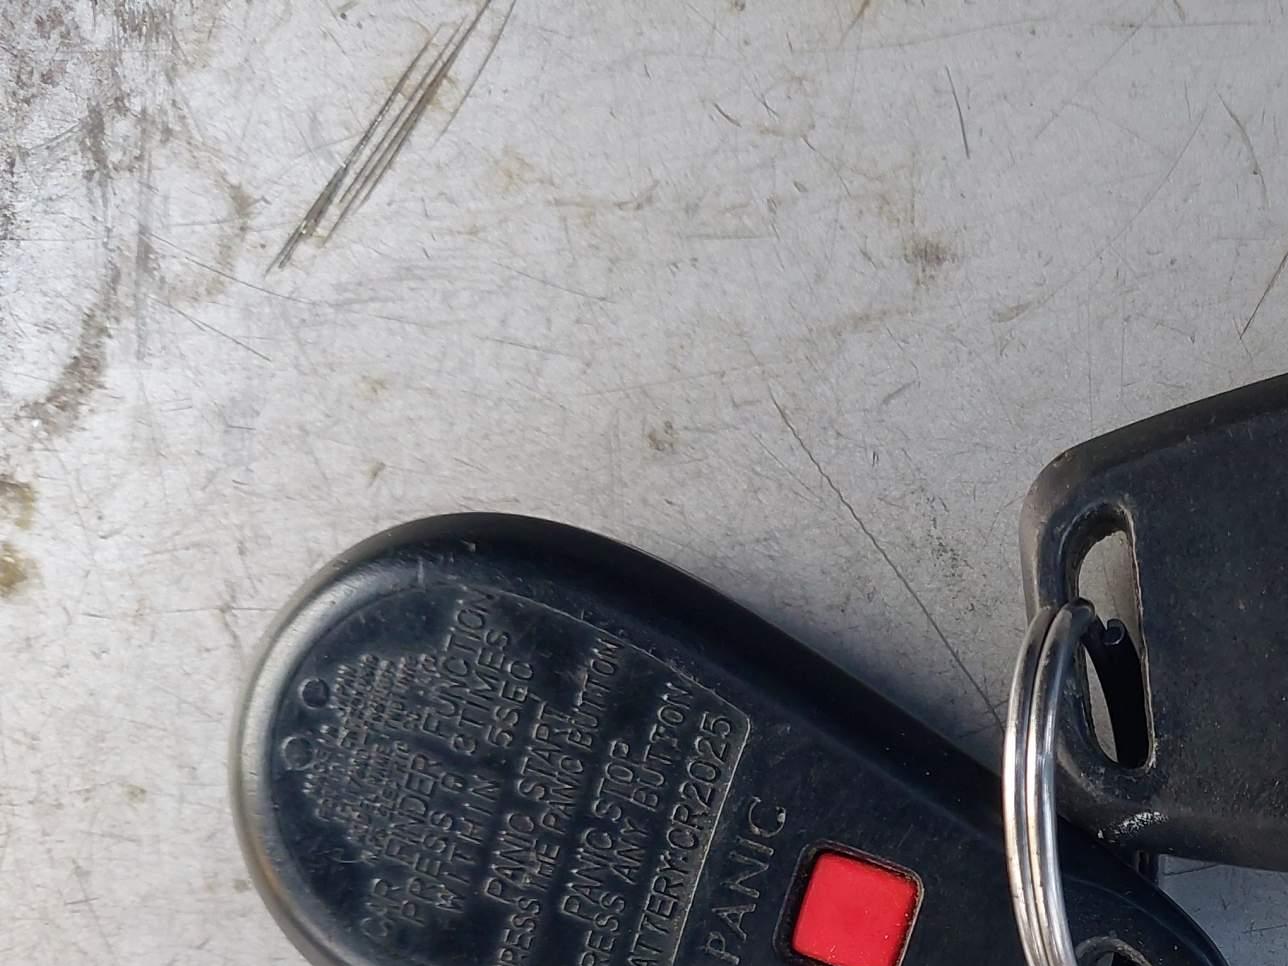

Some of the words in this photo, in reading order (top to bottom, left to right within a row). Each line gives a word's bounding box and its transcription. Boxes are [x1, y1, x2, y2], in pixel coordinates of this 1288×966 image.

[361, 878, 401, 937] CAR
[384, 754, 442, 866] FINDER
[422, 586, 494, 739] FUNCTION
[567, 638, 620, 750] BUTTON
[434, 775, 499, 913] WITHIN
[484, 813, 534, 904] PANIC
[517, 701, 567, 801] START
[541, 755, 583, 834] PANIC
[561, 827, 613, 922] PANIC
[593, 739, 638, 823] STOP
[611, 817, 648, 885] ANY
[630, 682, 693, 812] BUTTON
[401, 809, 454, 927] PRESS
[523, 840, 560, 891] THE
[701, 796, 787, 966] PANIC
